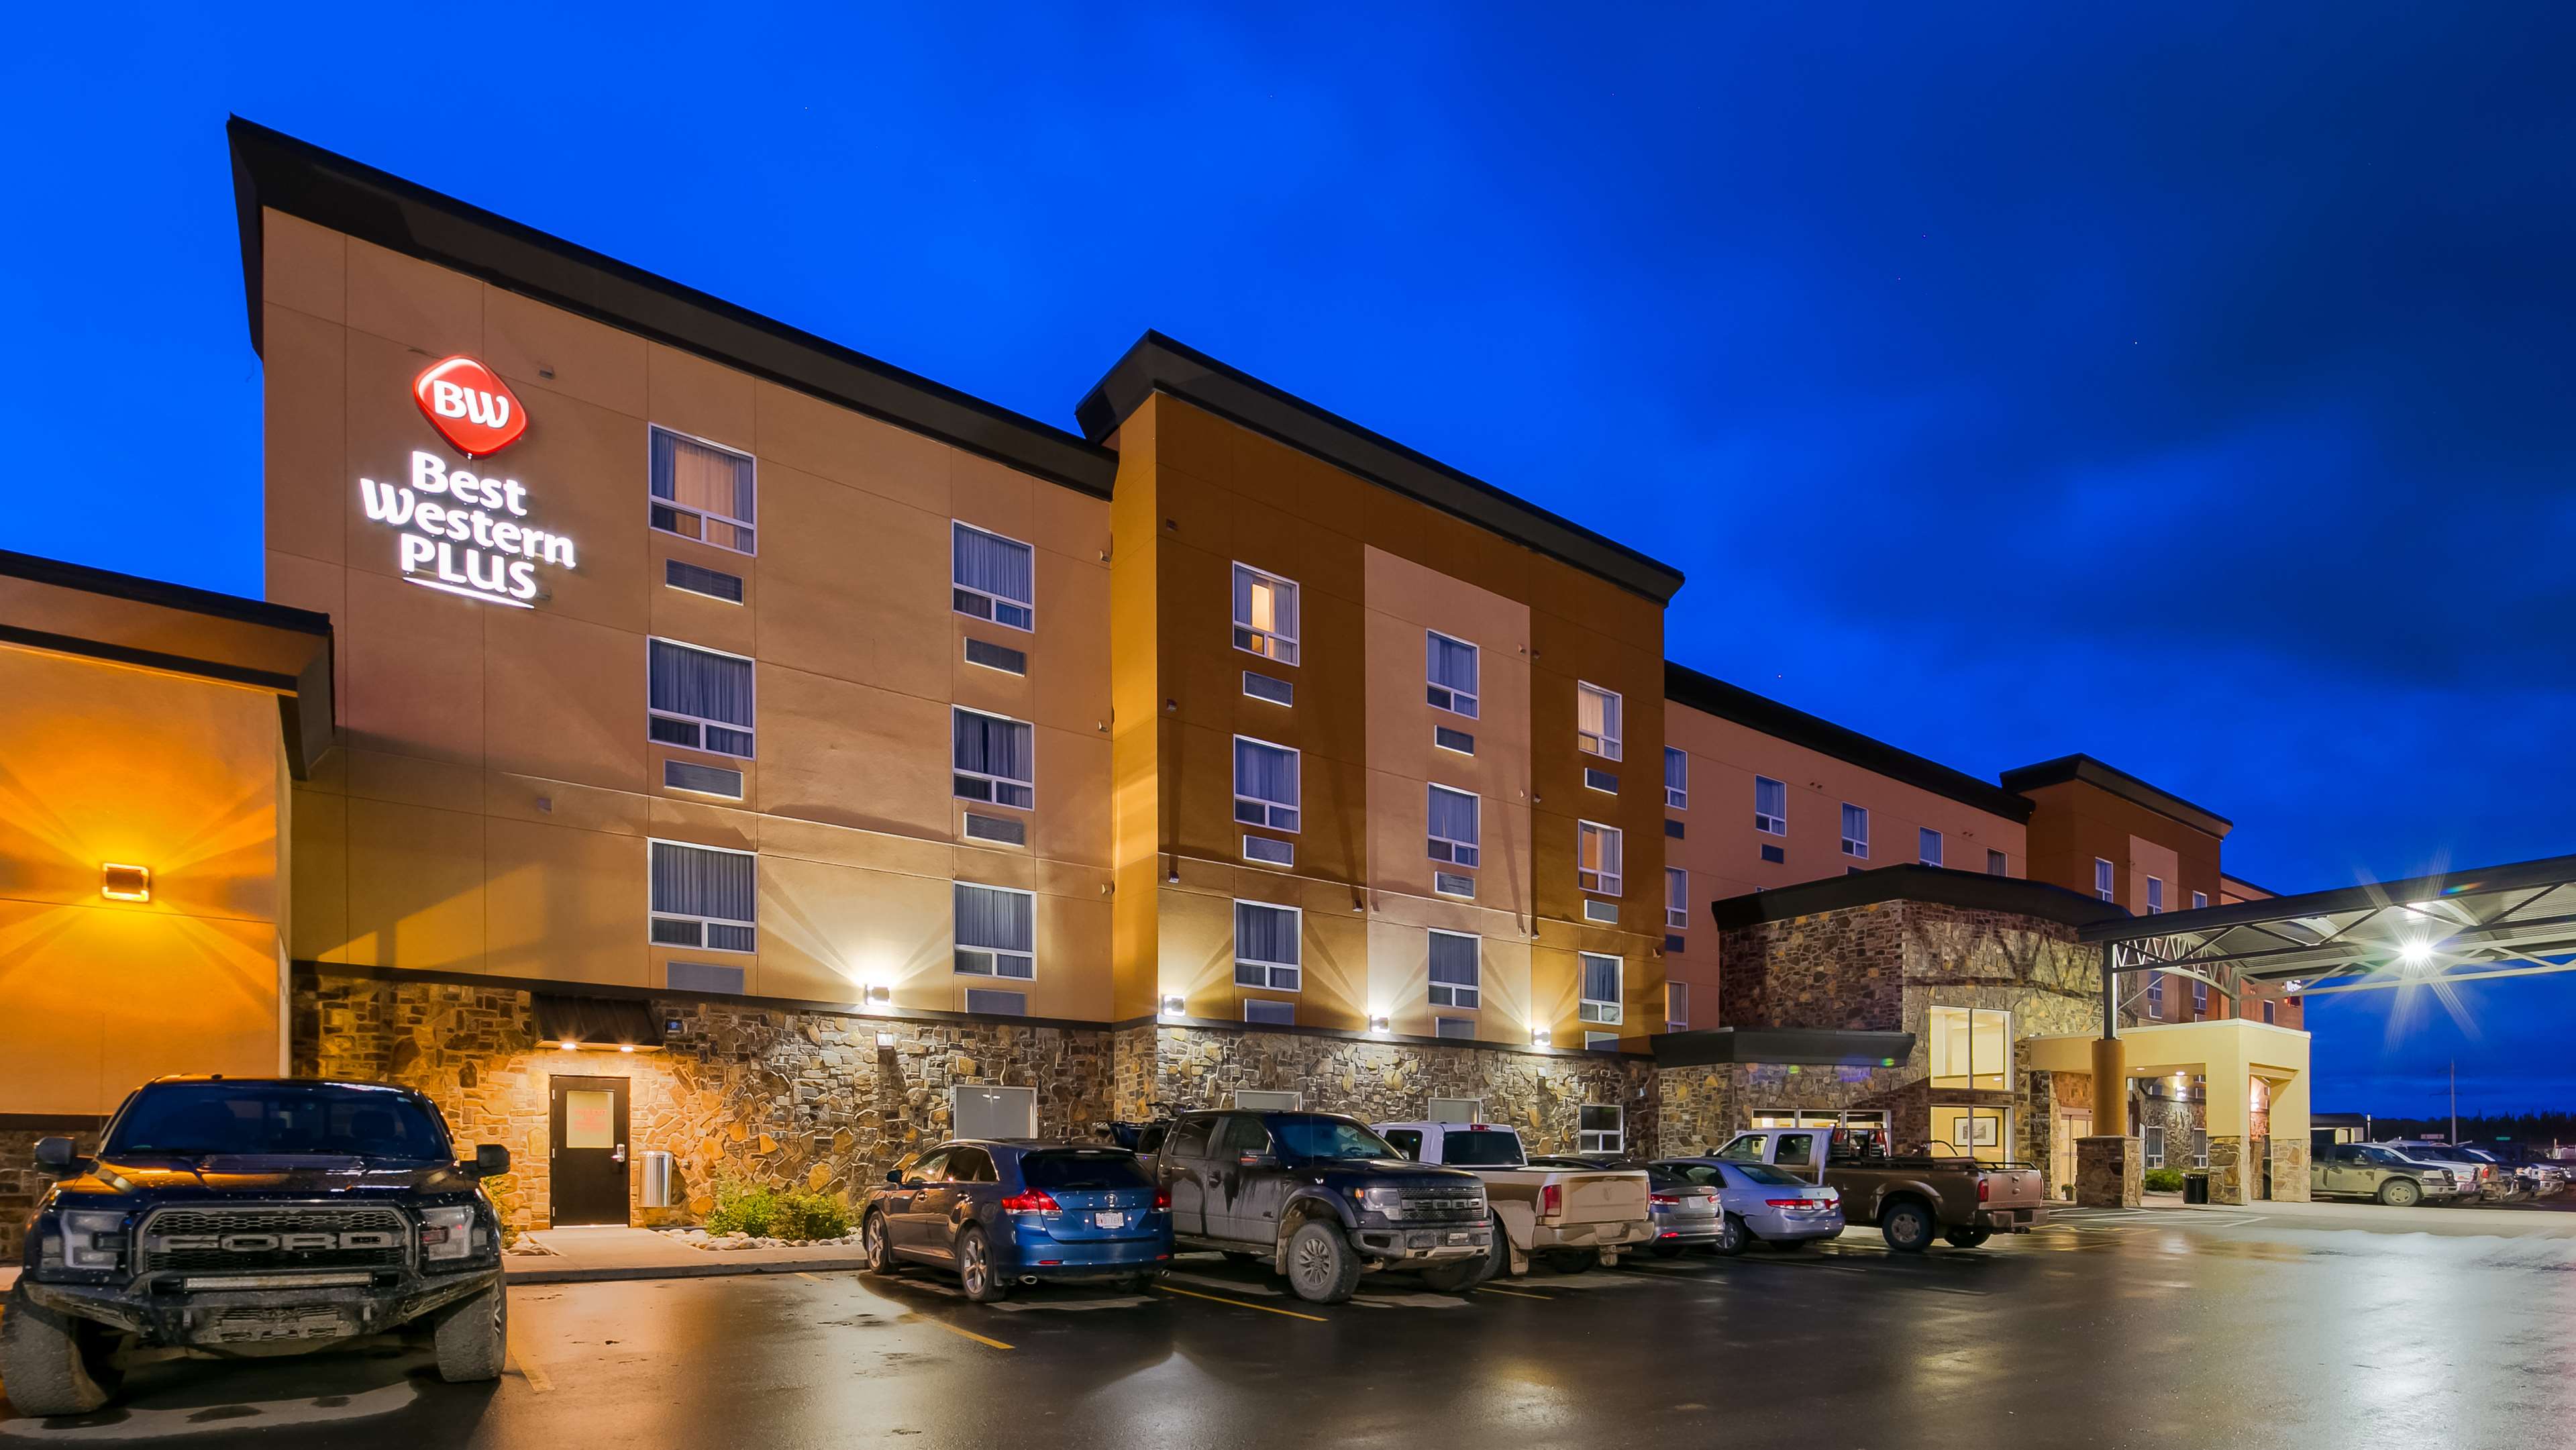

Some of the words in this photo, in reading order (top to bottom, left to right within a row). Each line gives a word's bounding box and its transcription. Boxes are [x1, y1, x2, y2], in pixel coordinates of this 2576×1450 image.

[433, 380, 509, 428] BW
[411, 450, 527, 517] Best
[360, 478, 576, 568] Western
[160, 1233, 393, 1251] FORD
